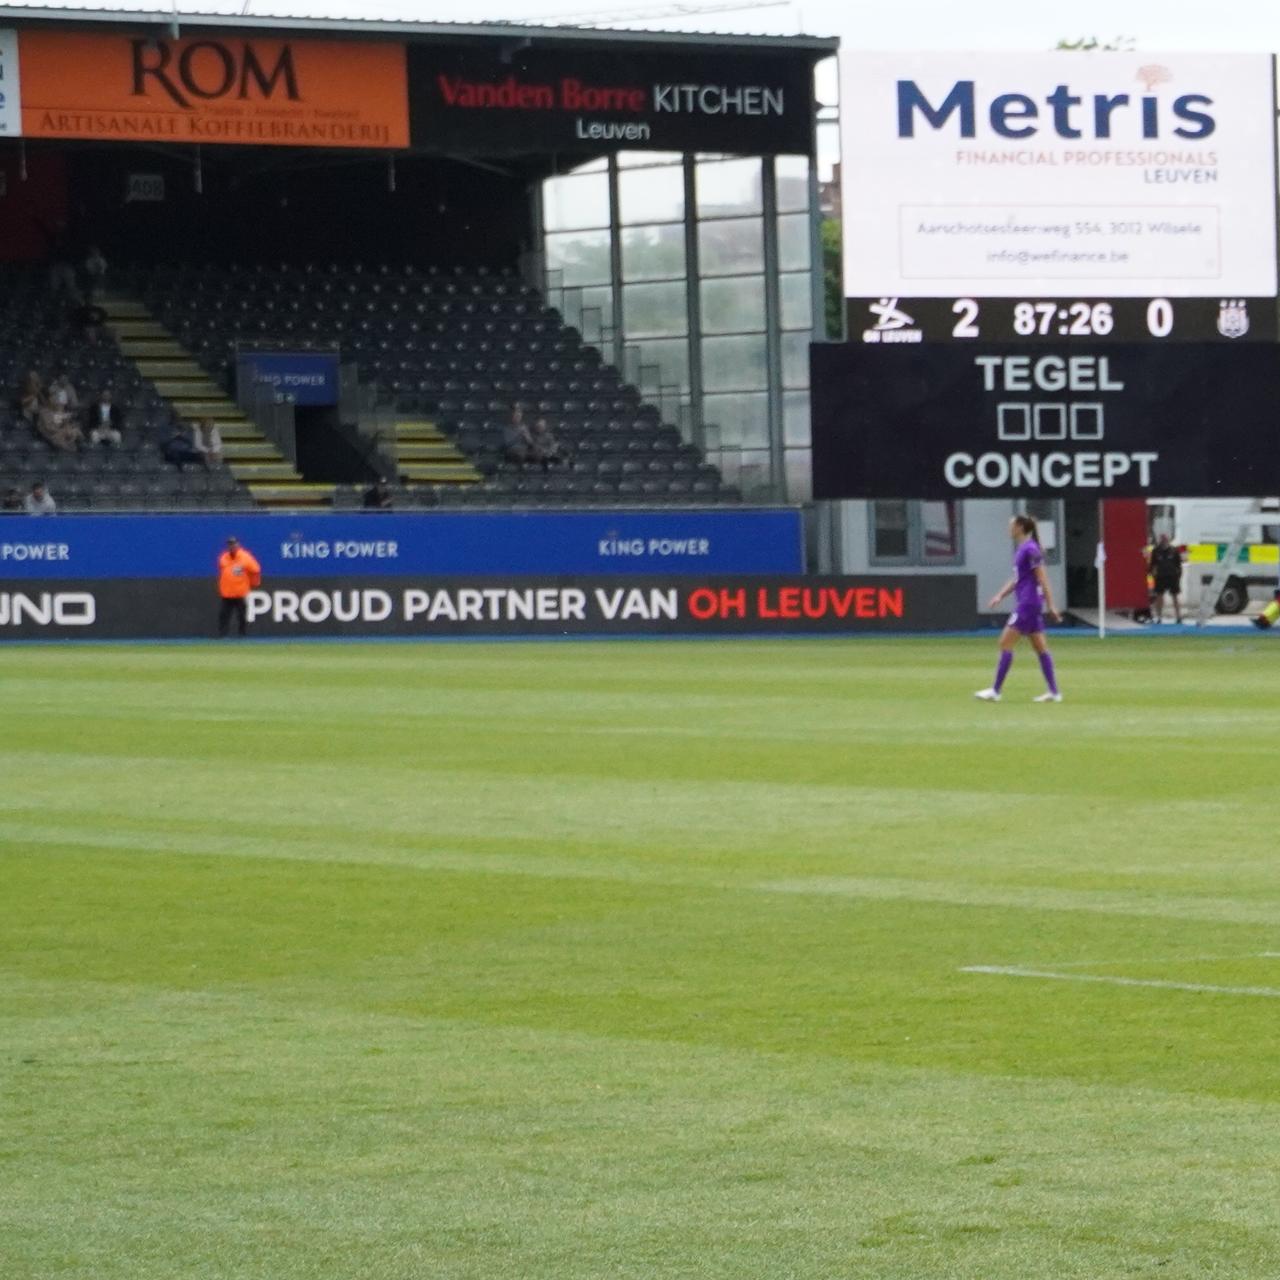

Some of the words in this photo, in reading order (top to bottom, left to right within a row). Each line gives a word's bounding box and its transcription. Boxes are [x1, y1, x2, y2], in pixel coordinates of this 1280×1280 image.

[130, 38, 303, 109] ROM
[438, 75, 554, 108] Vanden
[561, 78, 647, 111] Borre
[653, 84, 785, 116] KITCHEN
[896, 79, 1217, 140] Metris
[576, 118, 651, 140] Leuven
[956, 151, 1058, 166] FINANCIAL
[1063, 151, 1218, 167] PROFESSIONALS
[1143, 169, 1218, 184] LEUVEN
[952, 299, 980, 338] 2
[1012, 302, 1114, 336] 87:26
[1146, 298, 1174, 338] 0
[975, 355, 1125, 392] TEGEL
[943, 451, 1159, 488] CONCEPT
[2, 543, 70, 561] POWER
[281, 541, 330, 559] KING
[334, 541, 398, 558] POWER
[598, 538, 645, 557] KING
[649, 538, 710, 556] POWER
[0, 592, 97, 626] NO
[246, 589, 393, 623] PROUD
[404, 588, 586, 621] PARTNER
[595, 588, 678, 620] VAN
[688, 588, 745, 619] OH
[757, 587, 905, 619] LEUVEN
